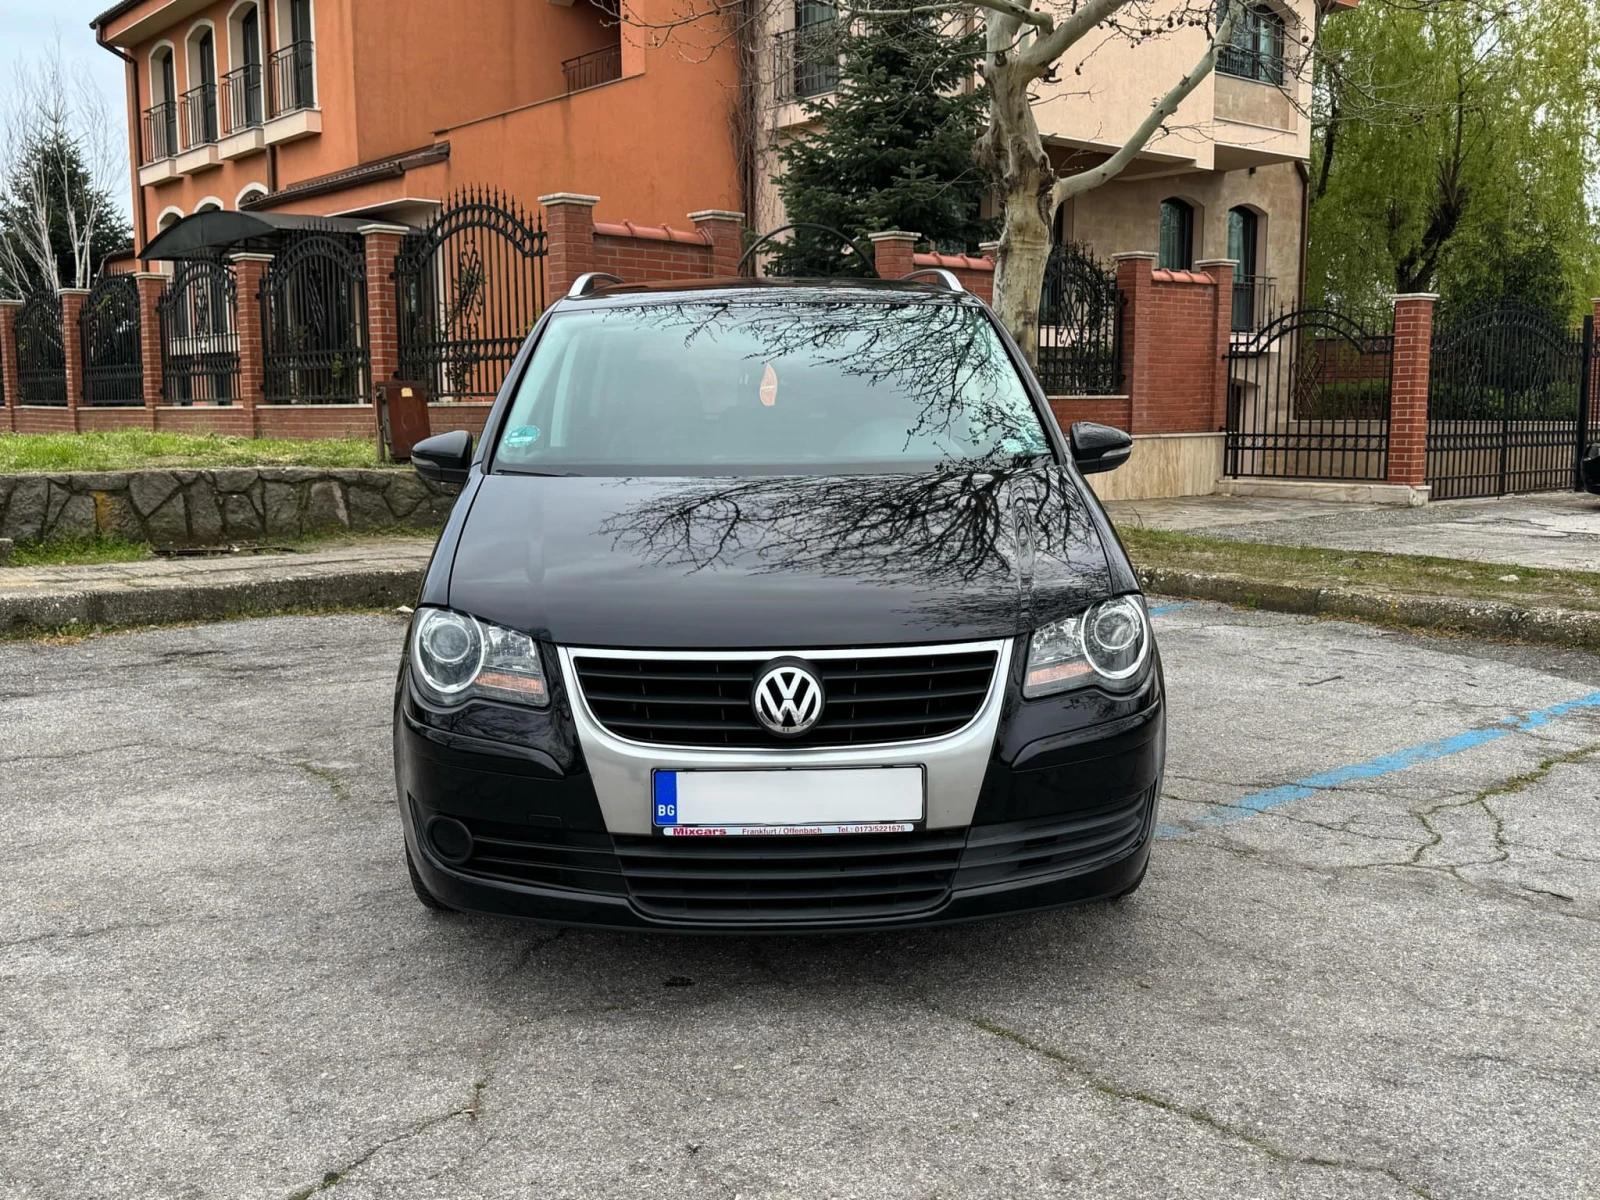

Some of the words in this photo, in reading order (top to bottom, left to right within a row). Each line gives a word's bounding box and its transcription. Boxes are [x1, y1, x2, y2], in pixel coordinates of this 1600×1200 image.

[755, 667, 821, 733] VW
[658, 804, 675, 816] BG
[672, 827, 727, 836] Mixcars
[783, 827, 823, 835] Offenbach
